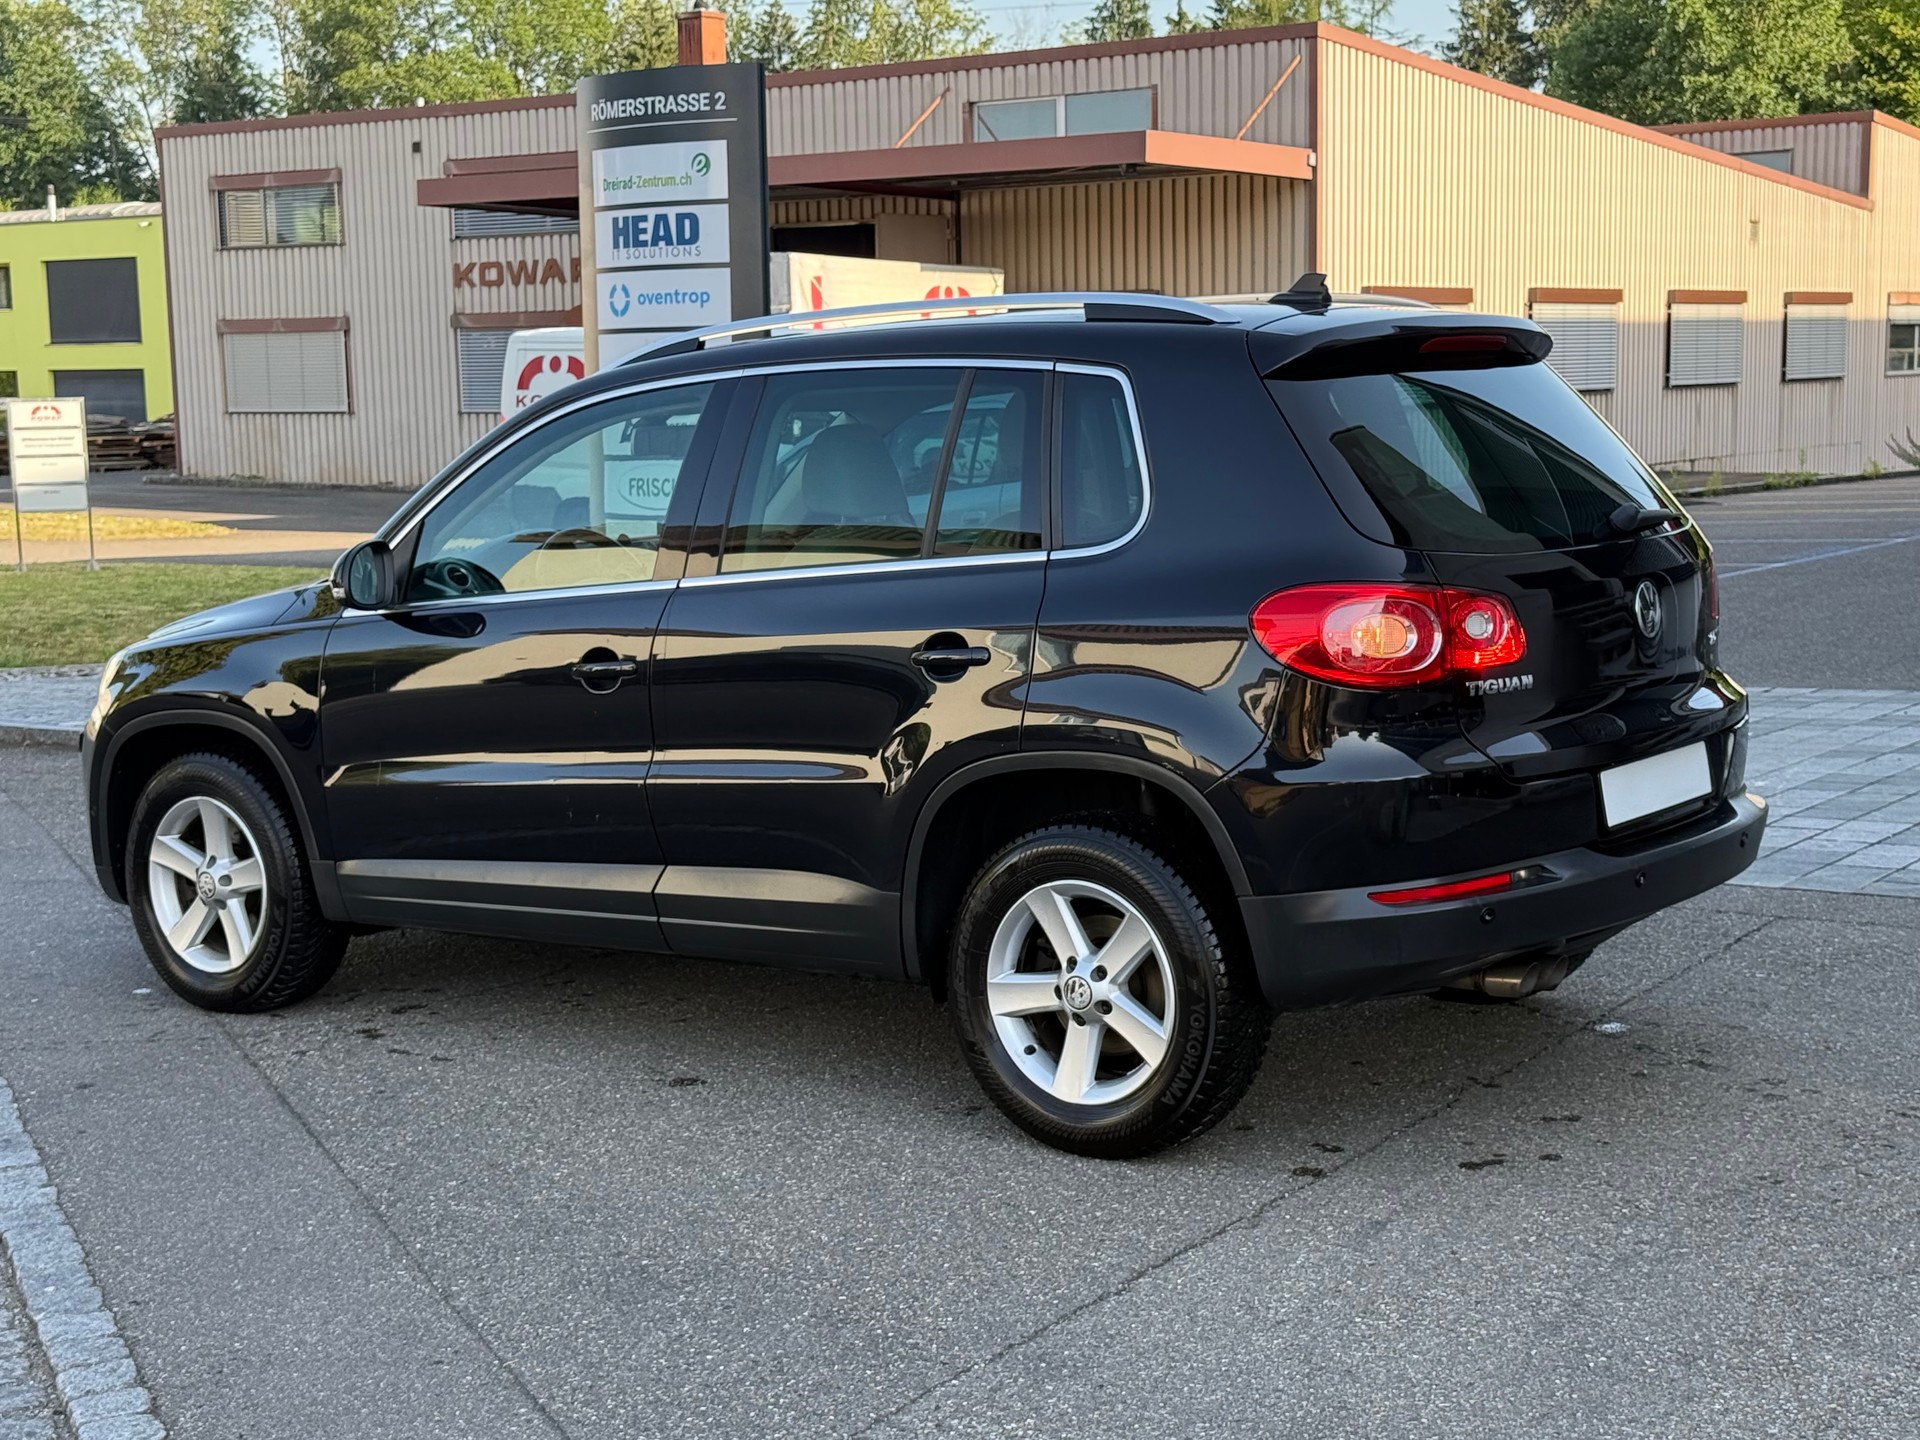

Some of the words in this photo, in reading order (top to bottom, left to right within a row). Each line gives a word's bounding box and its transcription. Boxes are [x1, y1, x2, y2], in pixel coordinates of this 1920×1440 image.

[591, 92, 711, 121] RÖMERSTRASSE
[714, 91, 727, 110] 2
[603, 171, 692, 192] Dreirad-Zentrum.ch
[612, 212, 700, 250] HEAD
[612, 250, 620, 261] IT
[625, 245, 702, 261] SOLUTIONS
[637, 288, 711, 308] oventrop
[628, 477, 676, 498] FRISC
[1466, 674, 1534, 697] TIGUAN
[1160, 1002, 1206, 1105] YOKOHAMA
